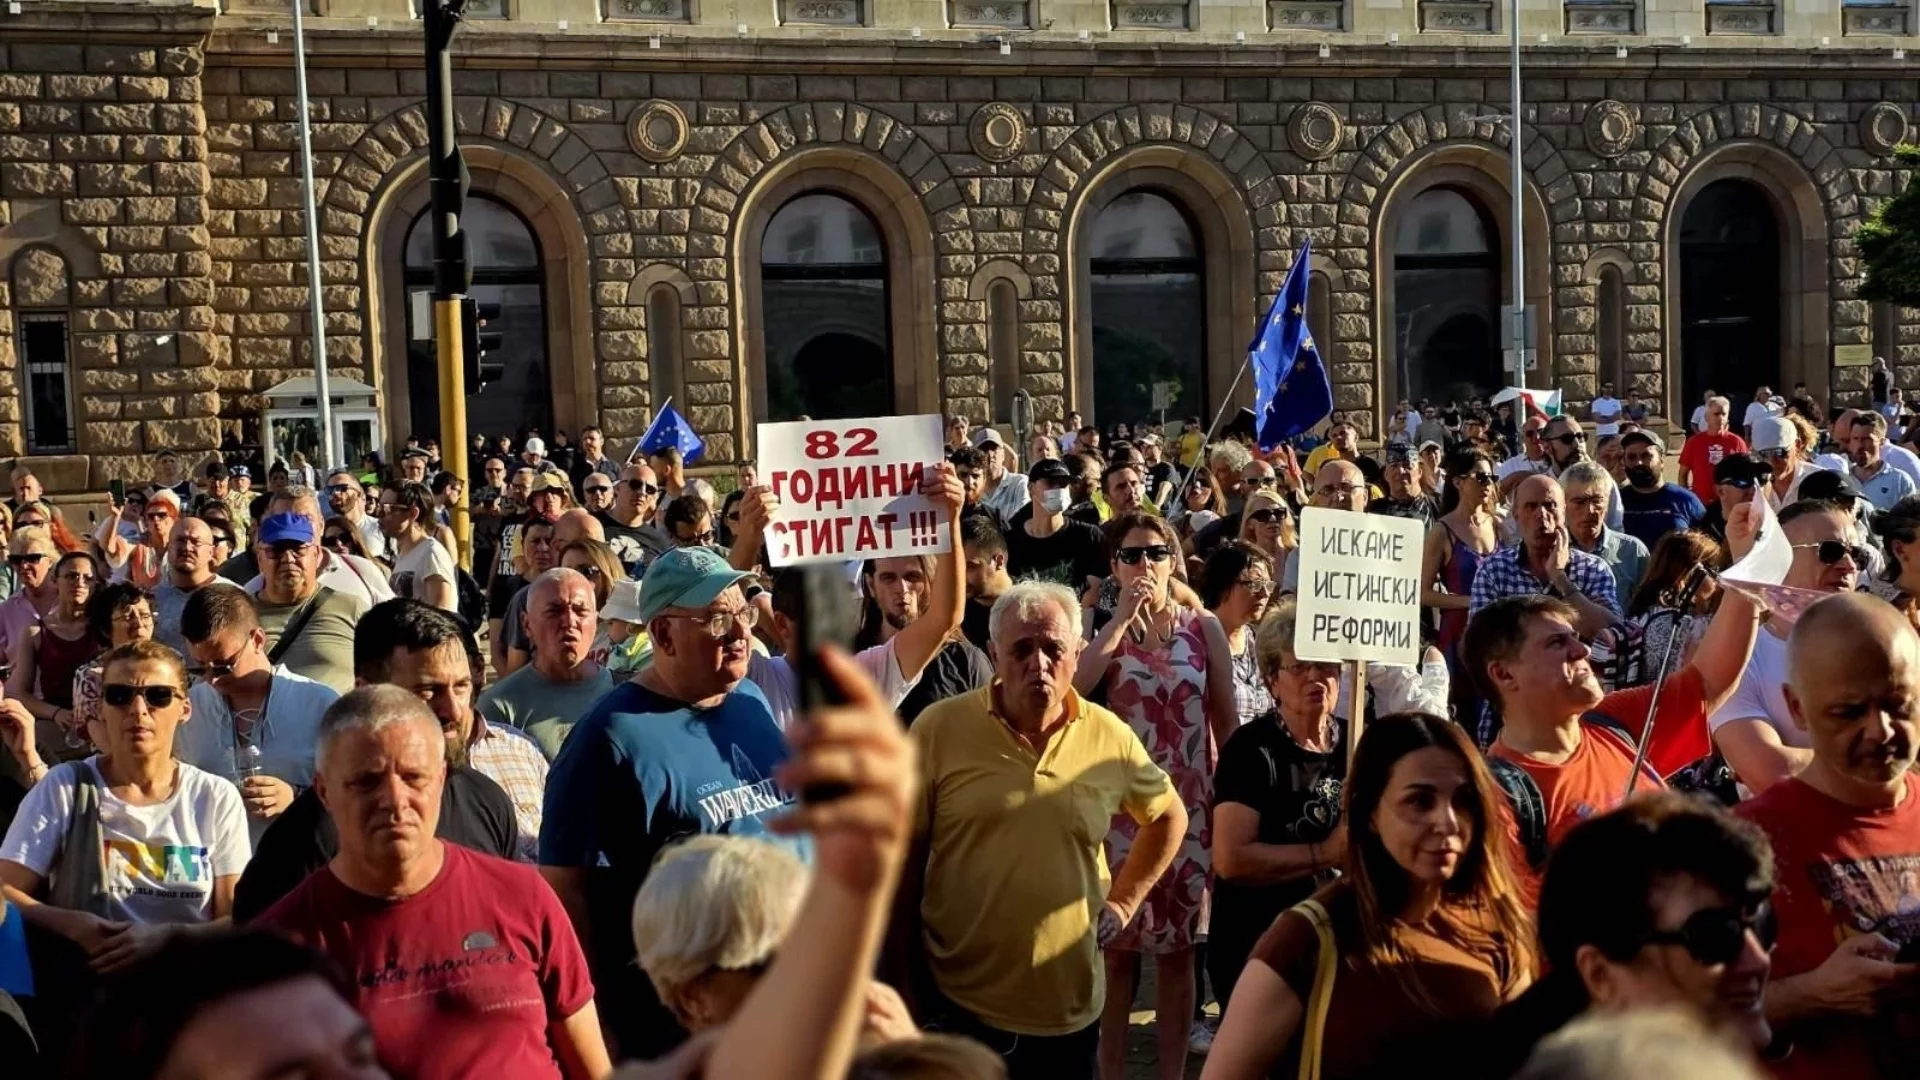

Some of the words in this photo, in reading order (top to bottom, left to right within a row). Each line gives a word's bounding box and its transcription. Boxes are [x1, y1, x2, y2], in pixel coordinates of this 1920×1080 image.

[804, 427, 879, 460] 82
[771, 461, 926, 512] ГОДИНИ
[771, 513, 898, 558] СТИГАТ
[909, 510, 938, 547] !!!
[1321, 526, 1404, 562] ИСКАМЕ
[1314, 570, 1417, 606] ИСТИНСКИ
[1312, 613, 1411, 649] РЕФОРМИ
[696, 780, 723, 795] OCEAN
